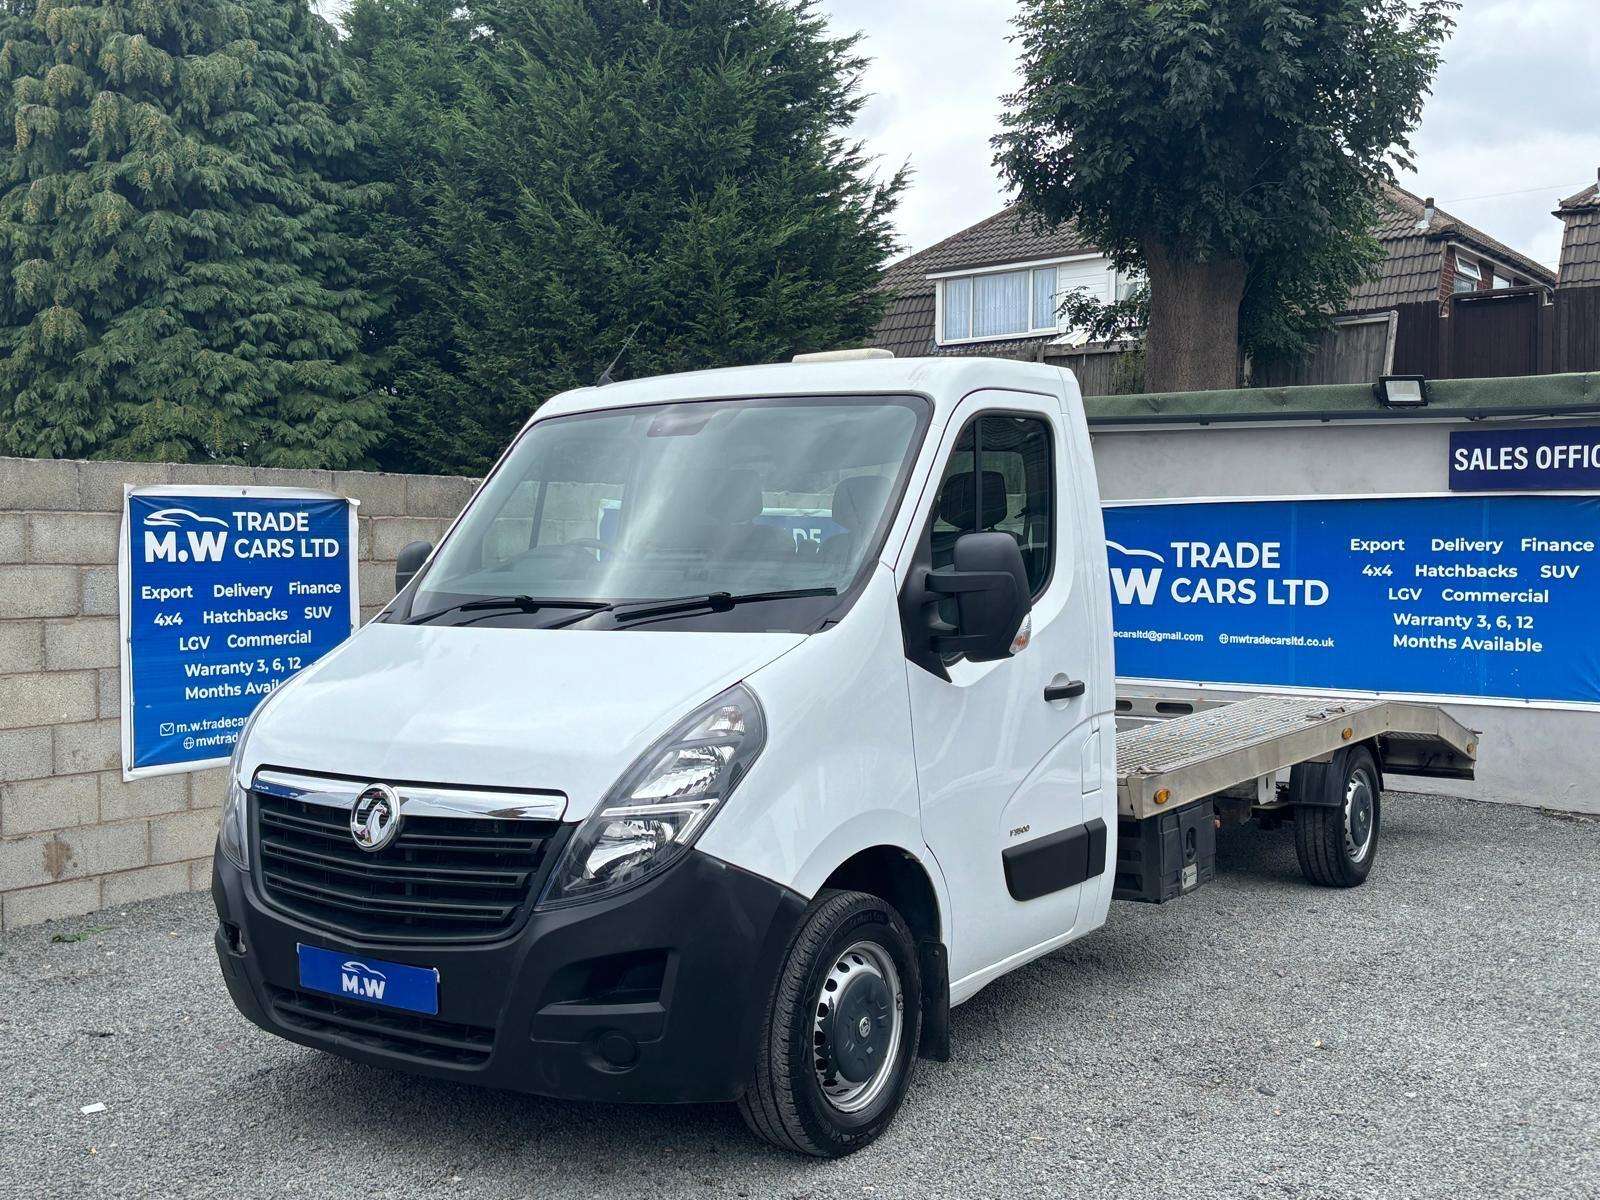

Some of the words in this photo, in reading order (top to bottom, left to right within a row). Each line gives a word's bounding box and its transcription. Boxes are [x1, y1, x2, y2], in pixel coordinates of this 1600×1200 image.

[1454, 447, 1528, 471] SALES
[232, 511, 309, 532] TRADE
[144, 531, 228, 563] M.W
[234, 538, 295, 558] CARS
[301, 539, 340, 558] LTD
[1171, 542, 1281, 569] TRADE
[1350, 538, 1405, 553] Export
[1431, 538, 1504, 554] Delivery
[1521, 537, 1595, 552] Finance
[1362, 565, 1393, 577] 4x4
[1415, 564, 1518, 578] Hatchbacks
[1540, 565, 1580, 579] SUV
[141, 586, 194, 602] Export
[213, 583, 273, 598] Delivery
[288, 581, 342, 595] Finance
[1170, 577, 1257, 604] CARS
[1267, 579, 1330, 606] LTD
[1388, 588, 1423, 601] LGV
[1441, 589, 1549, 603] Commercial
[154, 612, 183, 627] 4x4
[203, 608, 289, 624] Hatchbacks
[304, 606, 332, 620] SUV
[1393, 613, 1472, 630] Warranty
[1477, 615, 1492, 630] 3,
[1496, 616, 1512, 631] 6,
[1516, 616, 1534, 629] 12
[179, 636, 211, 651] LGV
[227, 631, 312, 648] Commercial
[1229, 634, 1334, 648] mwtradecarsltd.co.uk
[1393, 635, 1457, 649] Months
[1461, 637, 1543, 652] Available
[184, 660, 253, 678] Warranty
[257, 659, 269, 674] 3,
[272, 658, 285, 673] 6,
[288, 657, 301, 670] 12
[185, 683, 241, 700] Months
[342, 973, 386, 999] M.W
